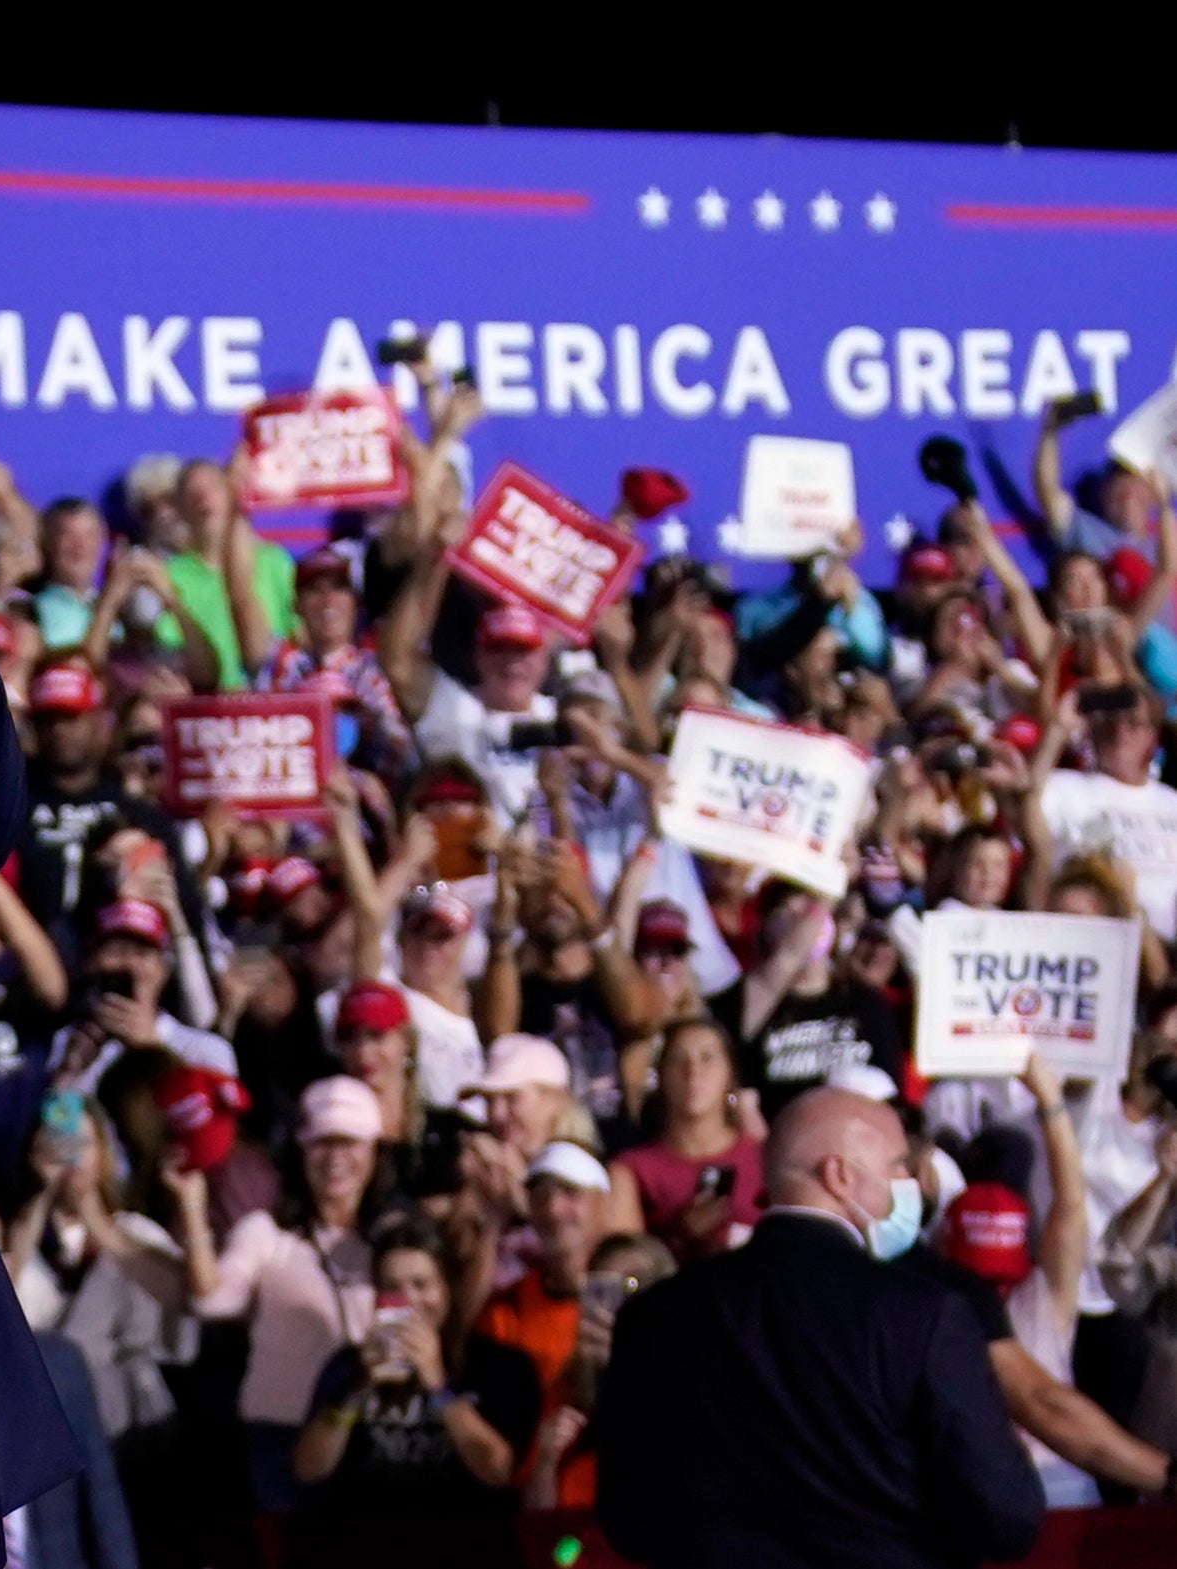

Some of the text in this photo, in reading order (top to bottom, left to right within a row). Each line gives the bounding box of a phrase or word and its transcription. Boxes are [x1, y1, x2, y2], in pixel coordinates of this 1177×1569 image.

[826, 325, 1132, 420] GREAT
[496, 486, 618, 573] TRUMP
[511, 530, 606, 603] VOTE
[175, 714, 315, 749] TRUMP
[207, 746, 318, 779] VOTE
[952, 953, 1100, 985] TRUMP
[985, 987, 1099, 1021] VOTE
